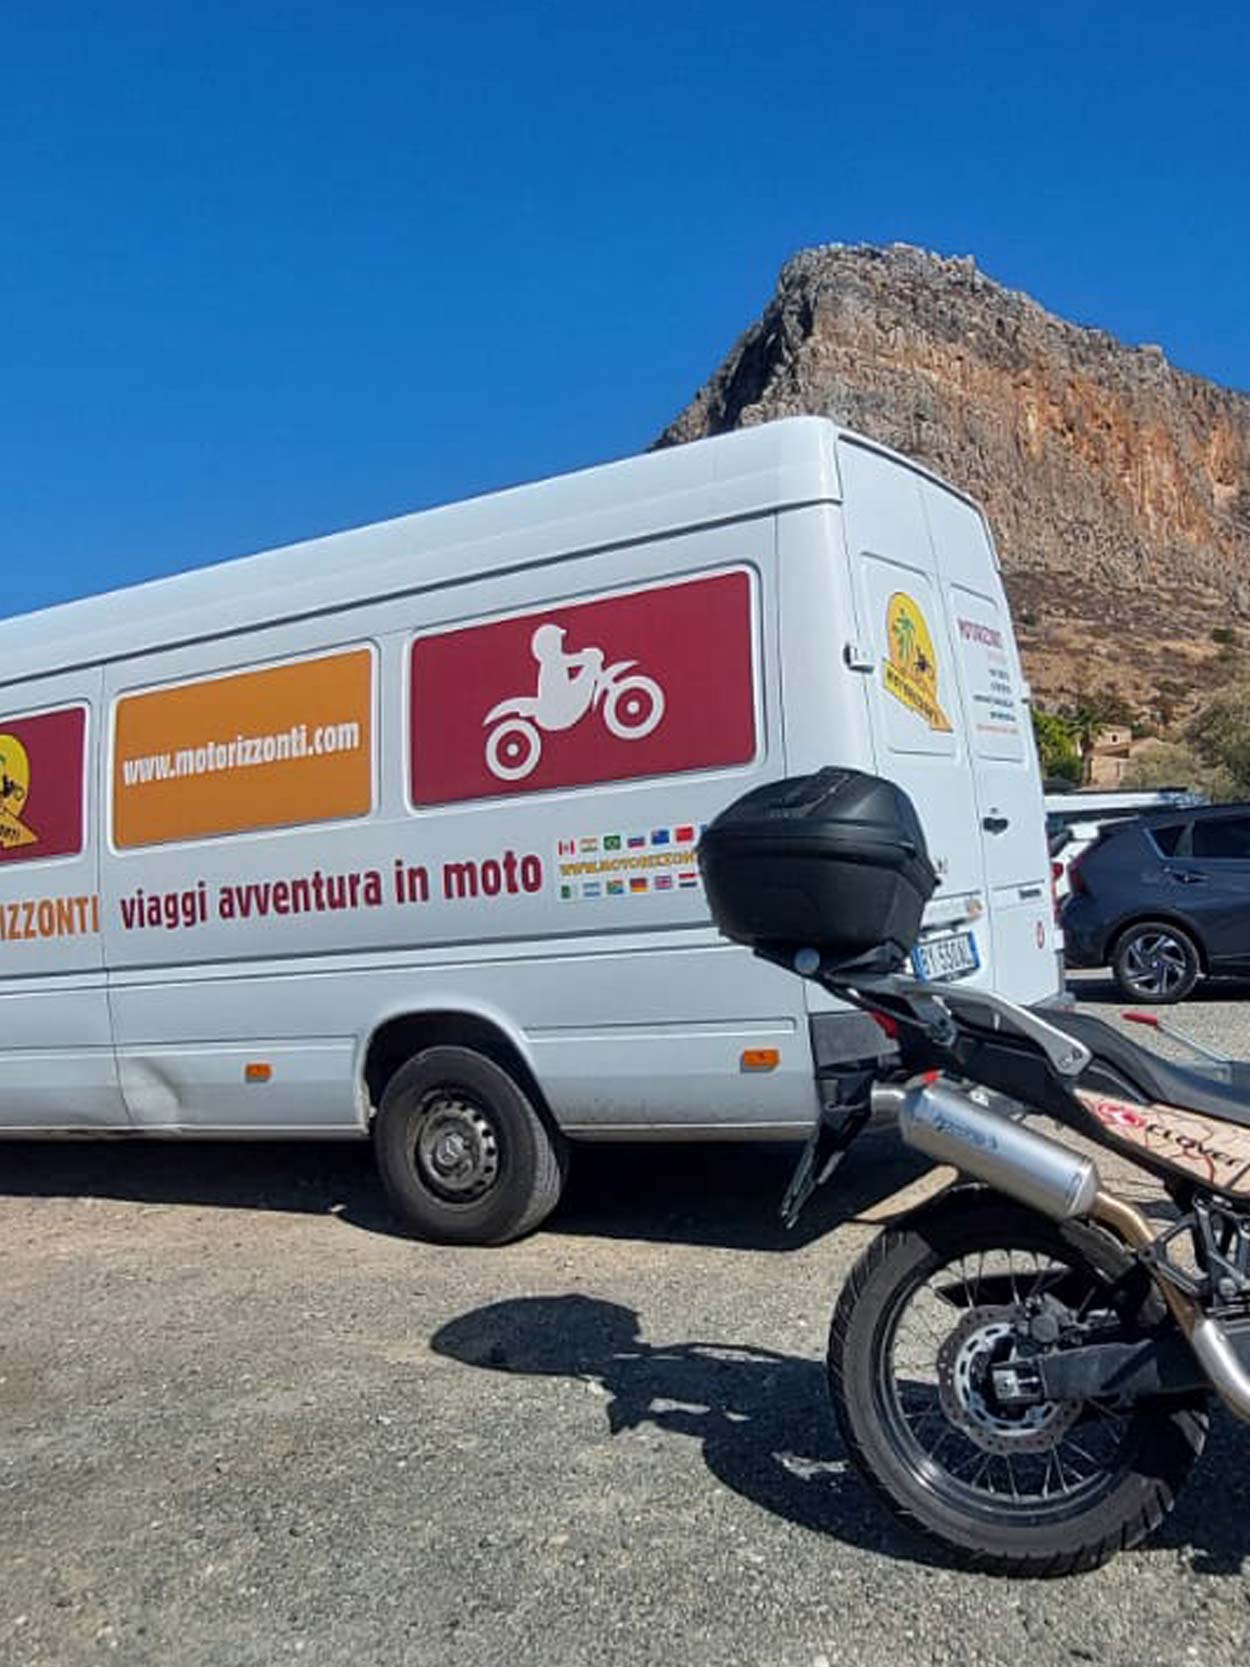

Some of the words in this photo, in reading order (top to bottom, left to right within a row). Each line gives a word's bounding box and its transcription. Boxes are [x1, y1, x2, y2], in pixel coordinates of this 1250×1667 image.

[122, 721, 360, 786] www.motorizzonti.com
[119, 881, 208, 930] viaggi
[218, 870, 382, 920] avventura
[394, 858, 430, 904] in
[442, 849, 543, 900] moto
